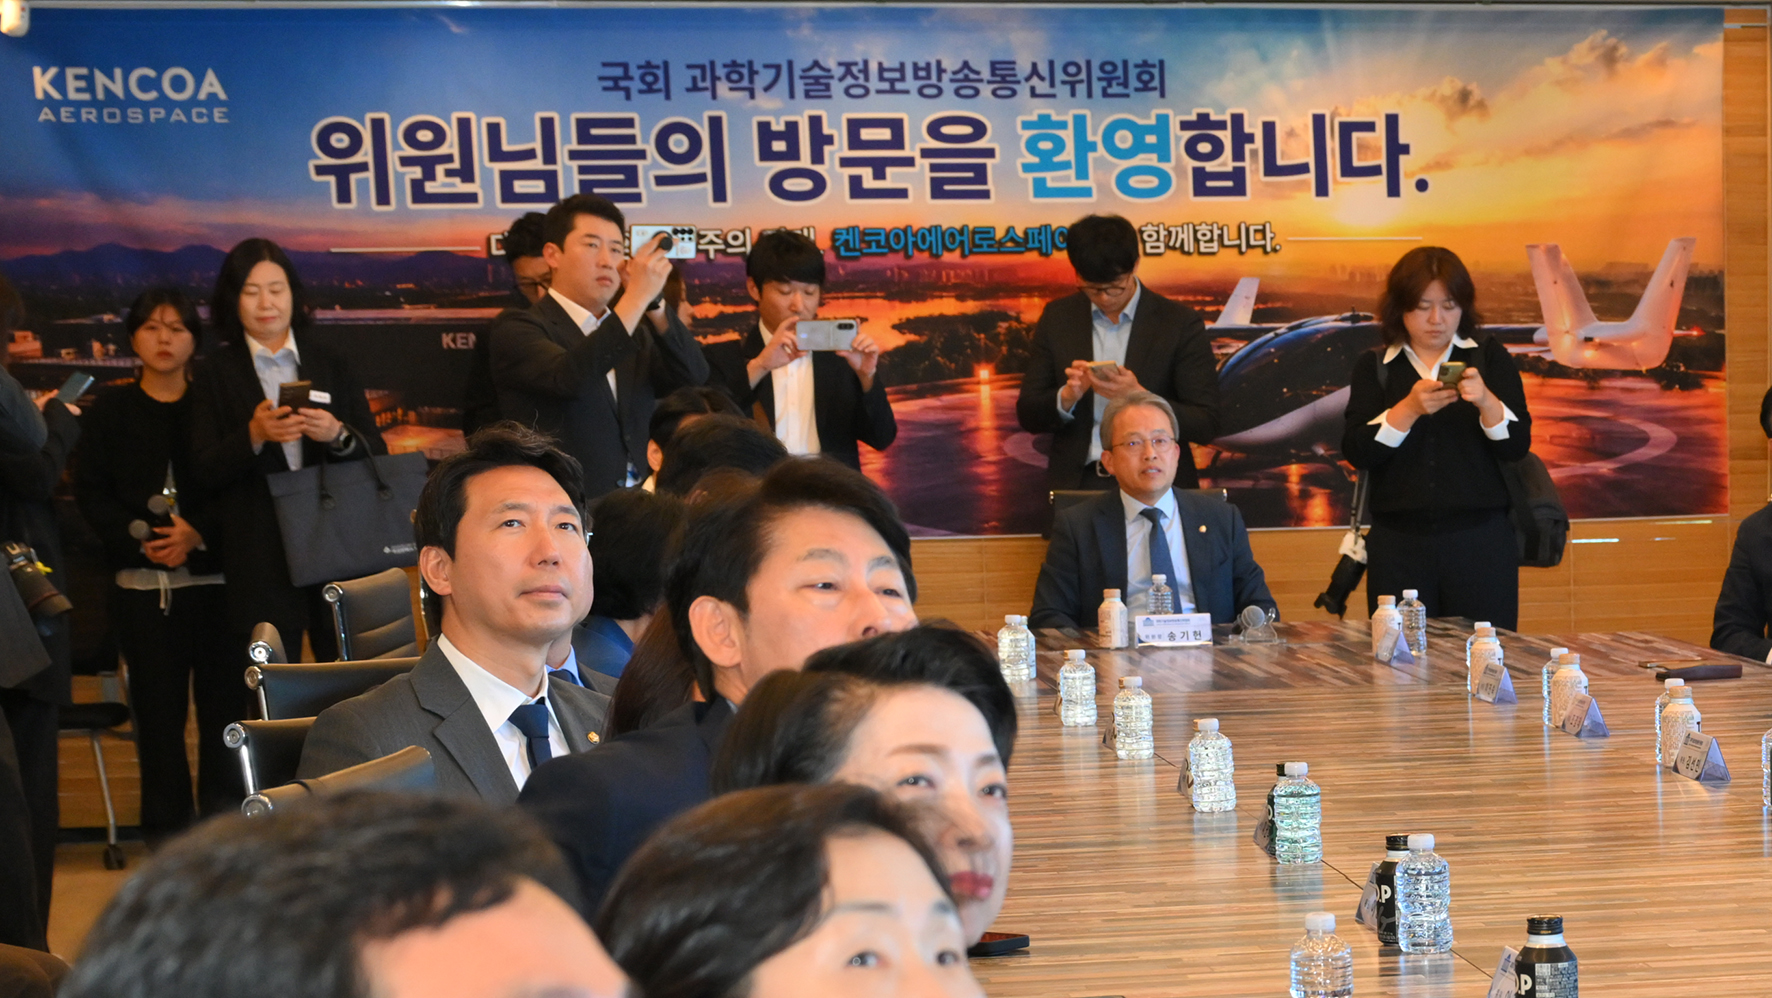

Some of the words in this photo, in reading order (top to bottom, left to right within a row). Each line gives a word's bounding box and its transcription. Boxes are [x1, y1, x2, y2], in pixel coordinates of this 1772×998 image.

[32, 66, 229, 101] KENCOA
[597, 60, 672, 101] 국회
[684, 58, 1167, 101] 과학기술정보방송통신위원회
[38, 106, 230, 124] AEROSPACE
[310, 111, 730, 209] 위원님들의
[753, 109, 999, 206] 방문을
[1016, 107, 1431, 203] 환영합니다.
[833, 225, 1068, 257] 켄코아에어로스페
[1140, 221, 1282, 255] 함께합니다.
